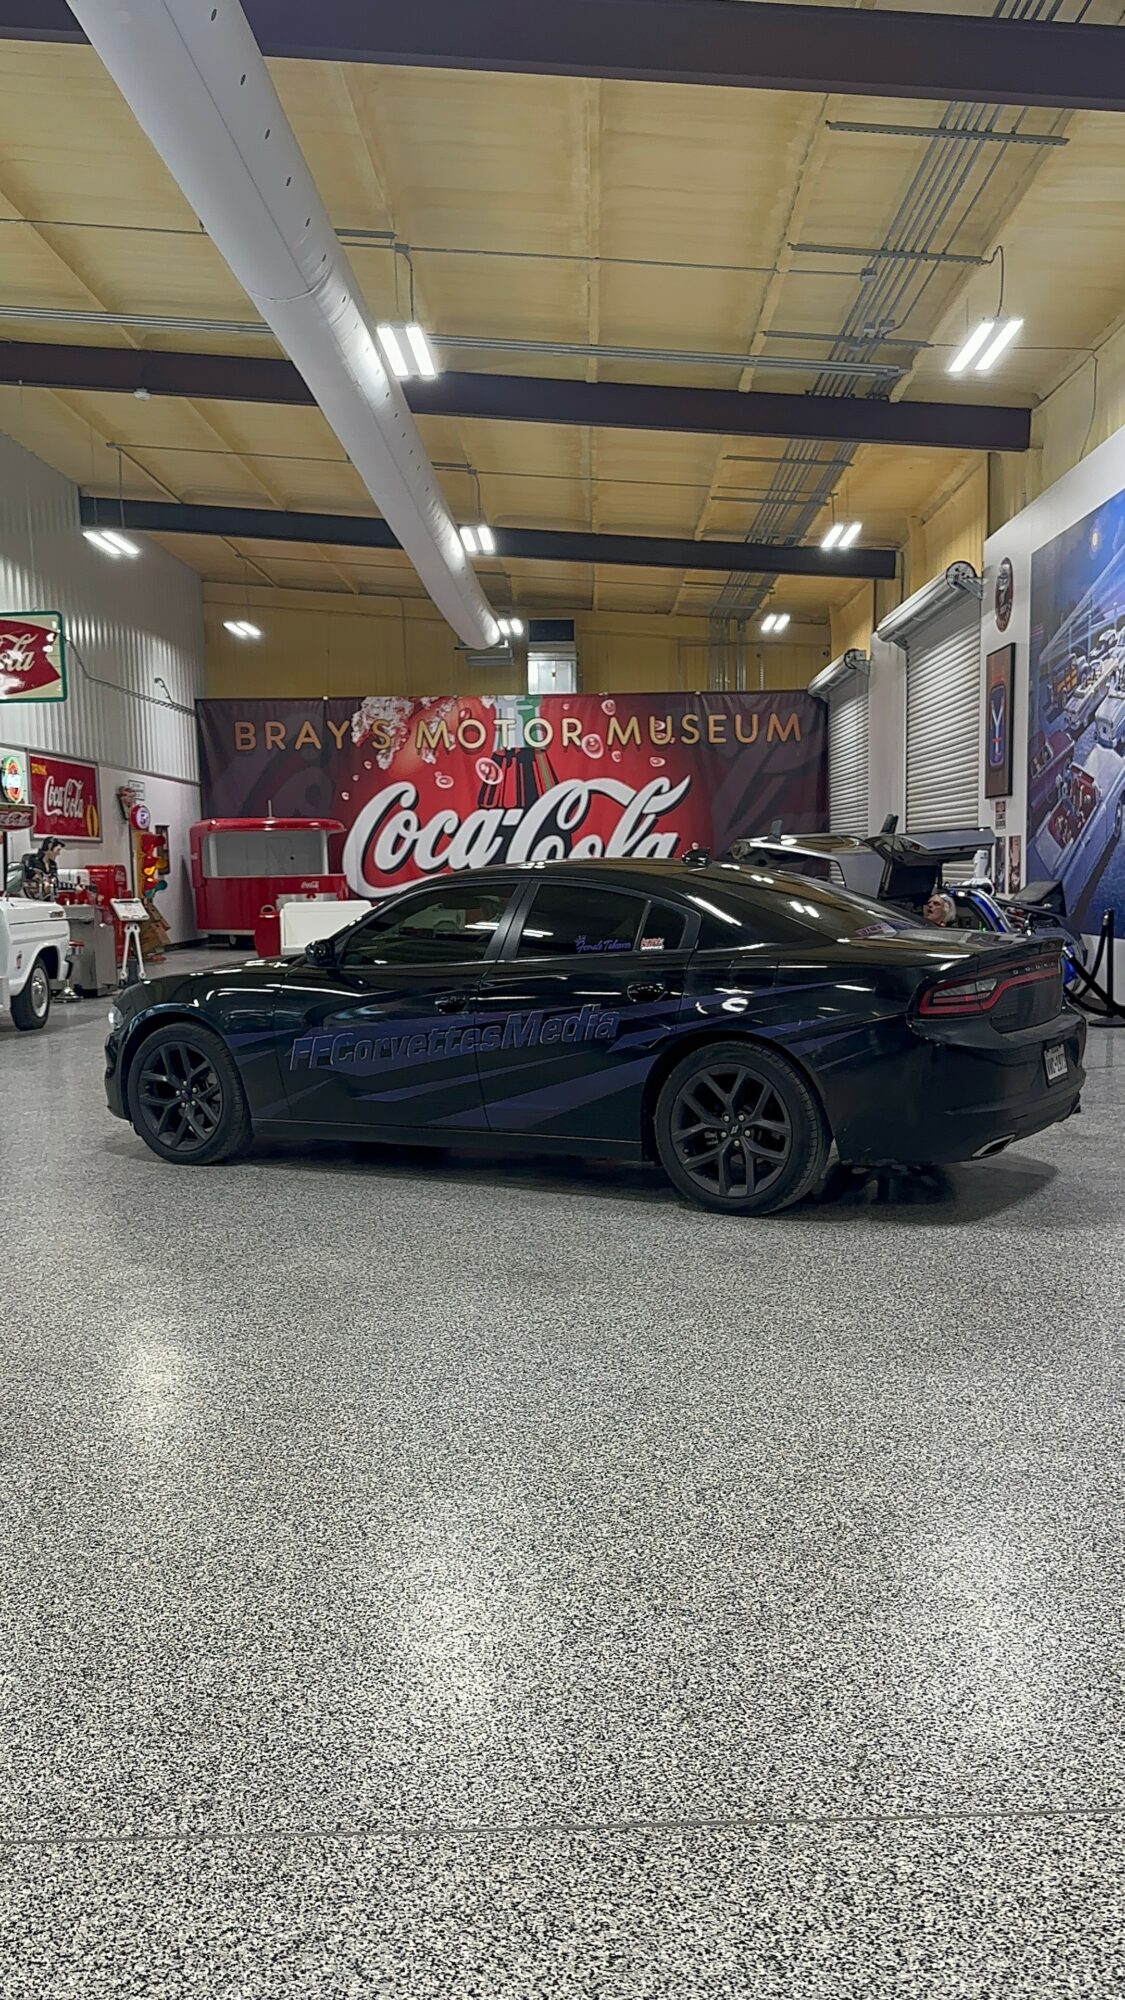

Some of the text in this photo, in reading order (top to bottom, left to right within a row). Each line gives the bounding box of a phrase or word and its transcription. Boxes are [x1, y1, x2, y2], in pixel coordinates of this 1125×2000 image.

[415, 718, 582, 749] MOTOR
[606, 712, 802, 746] MUSEUM
[289, 1003, 621, 1071] FFCorvettesMedia
